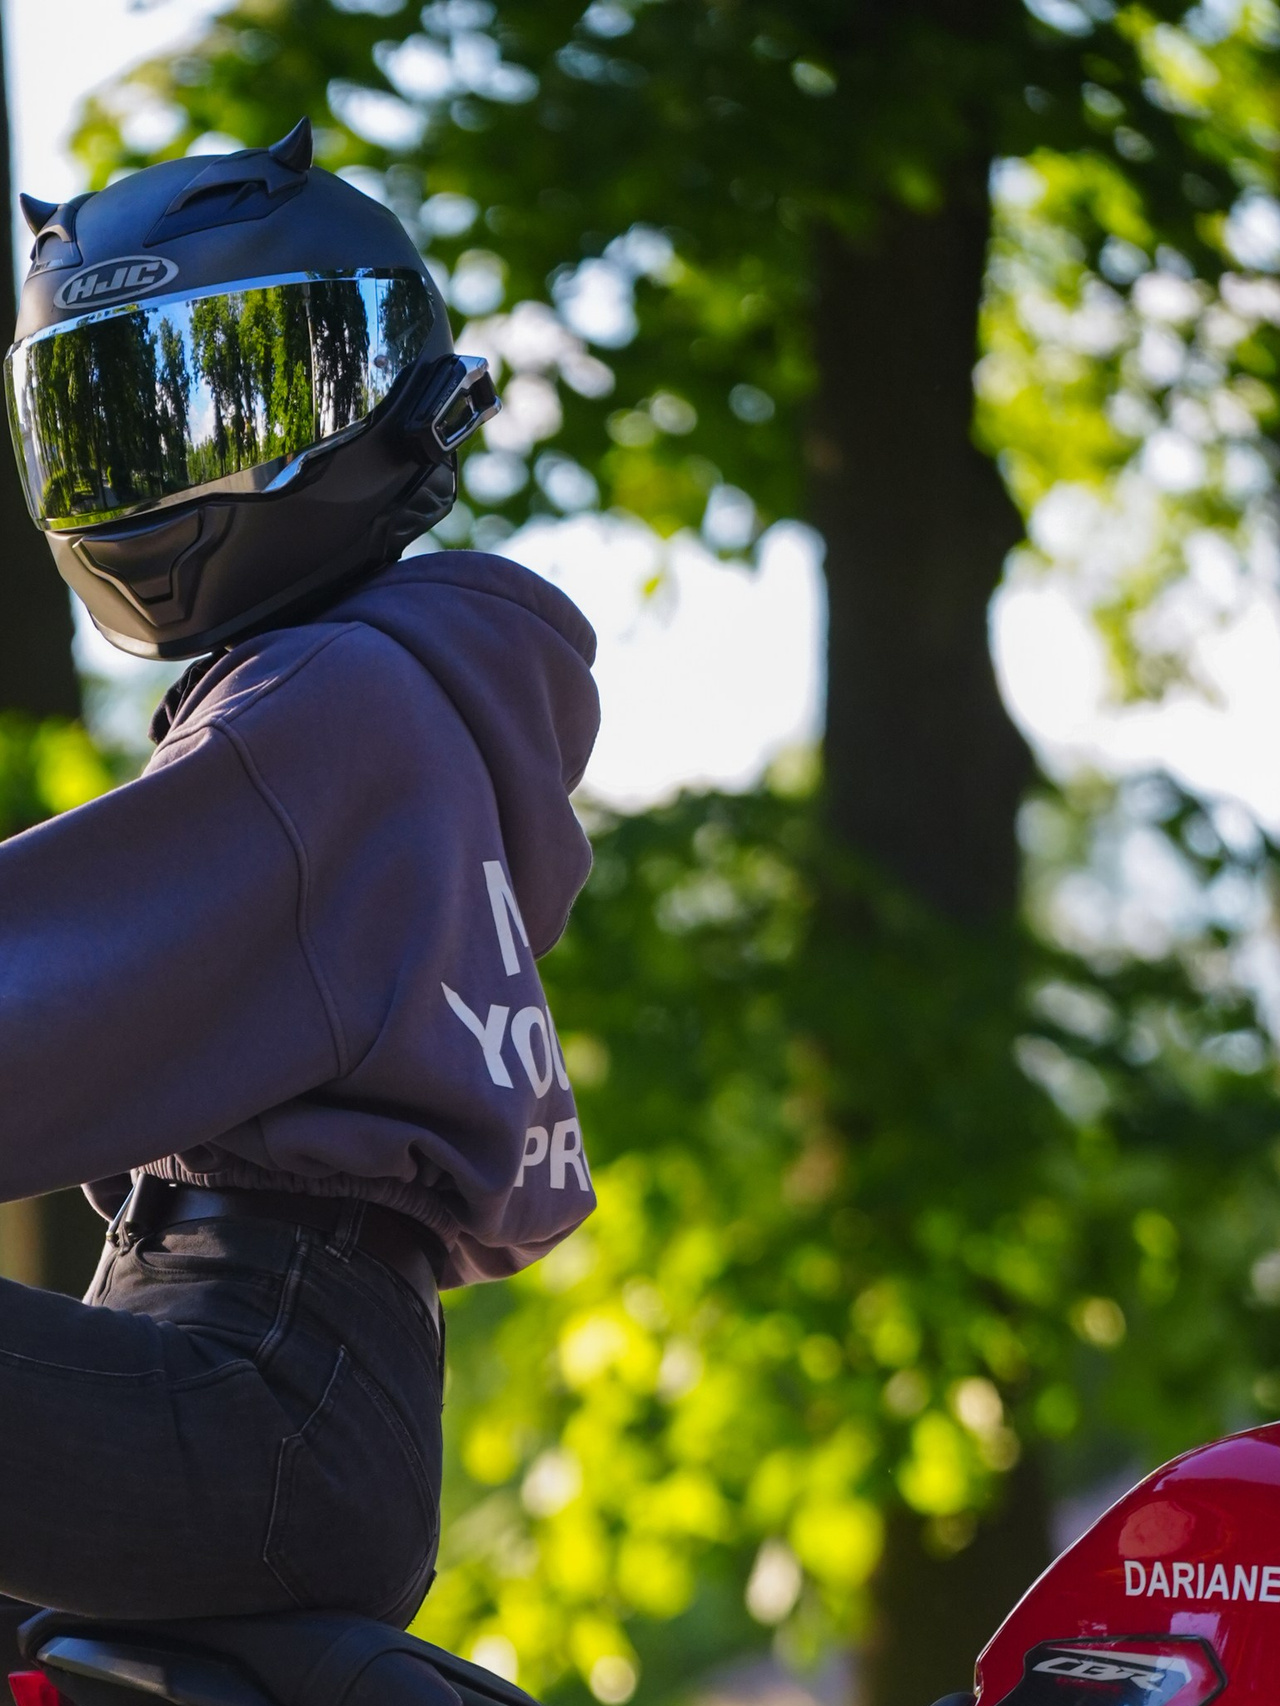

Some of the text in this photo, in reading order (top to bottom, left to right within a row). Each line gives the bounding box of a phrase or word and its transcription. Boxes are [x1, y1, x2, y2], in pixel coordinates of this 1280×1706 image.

[66, 260, 162, 305] HJC
[514, 1117, 592, 1192] PR
[1124, 1560, 1280, 1603] DARIANE
[1032, 1656, 1163, 1692] CBR
